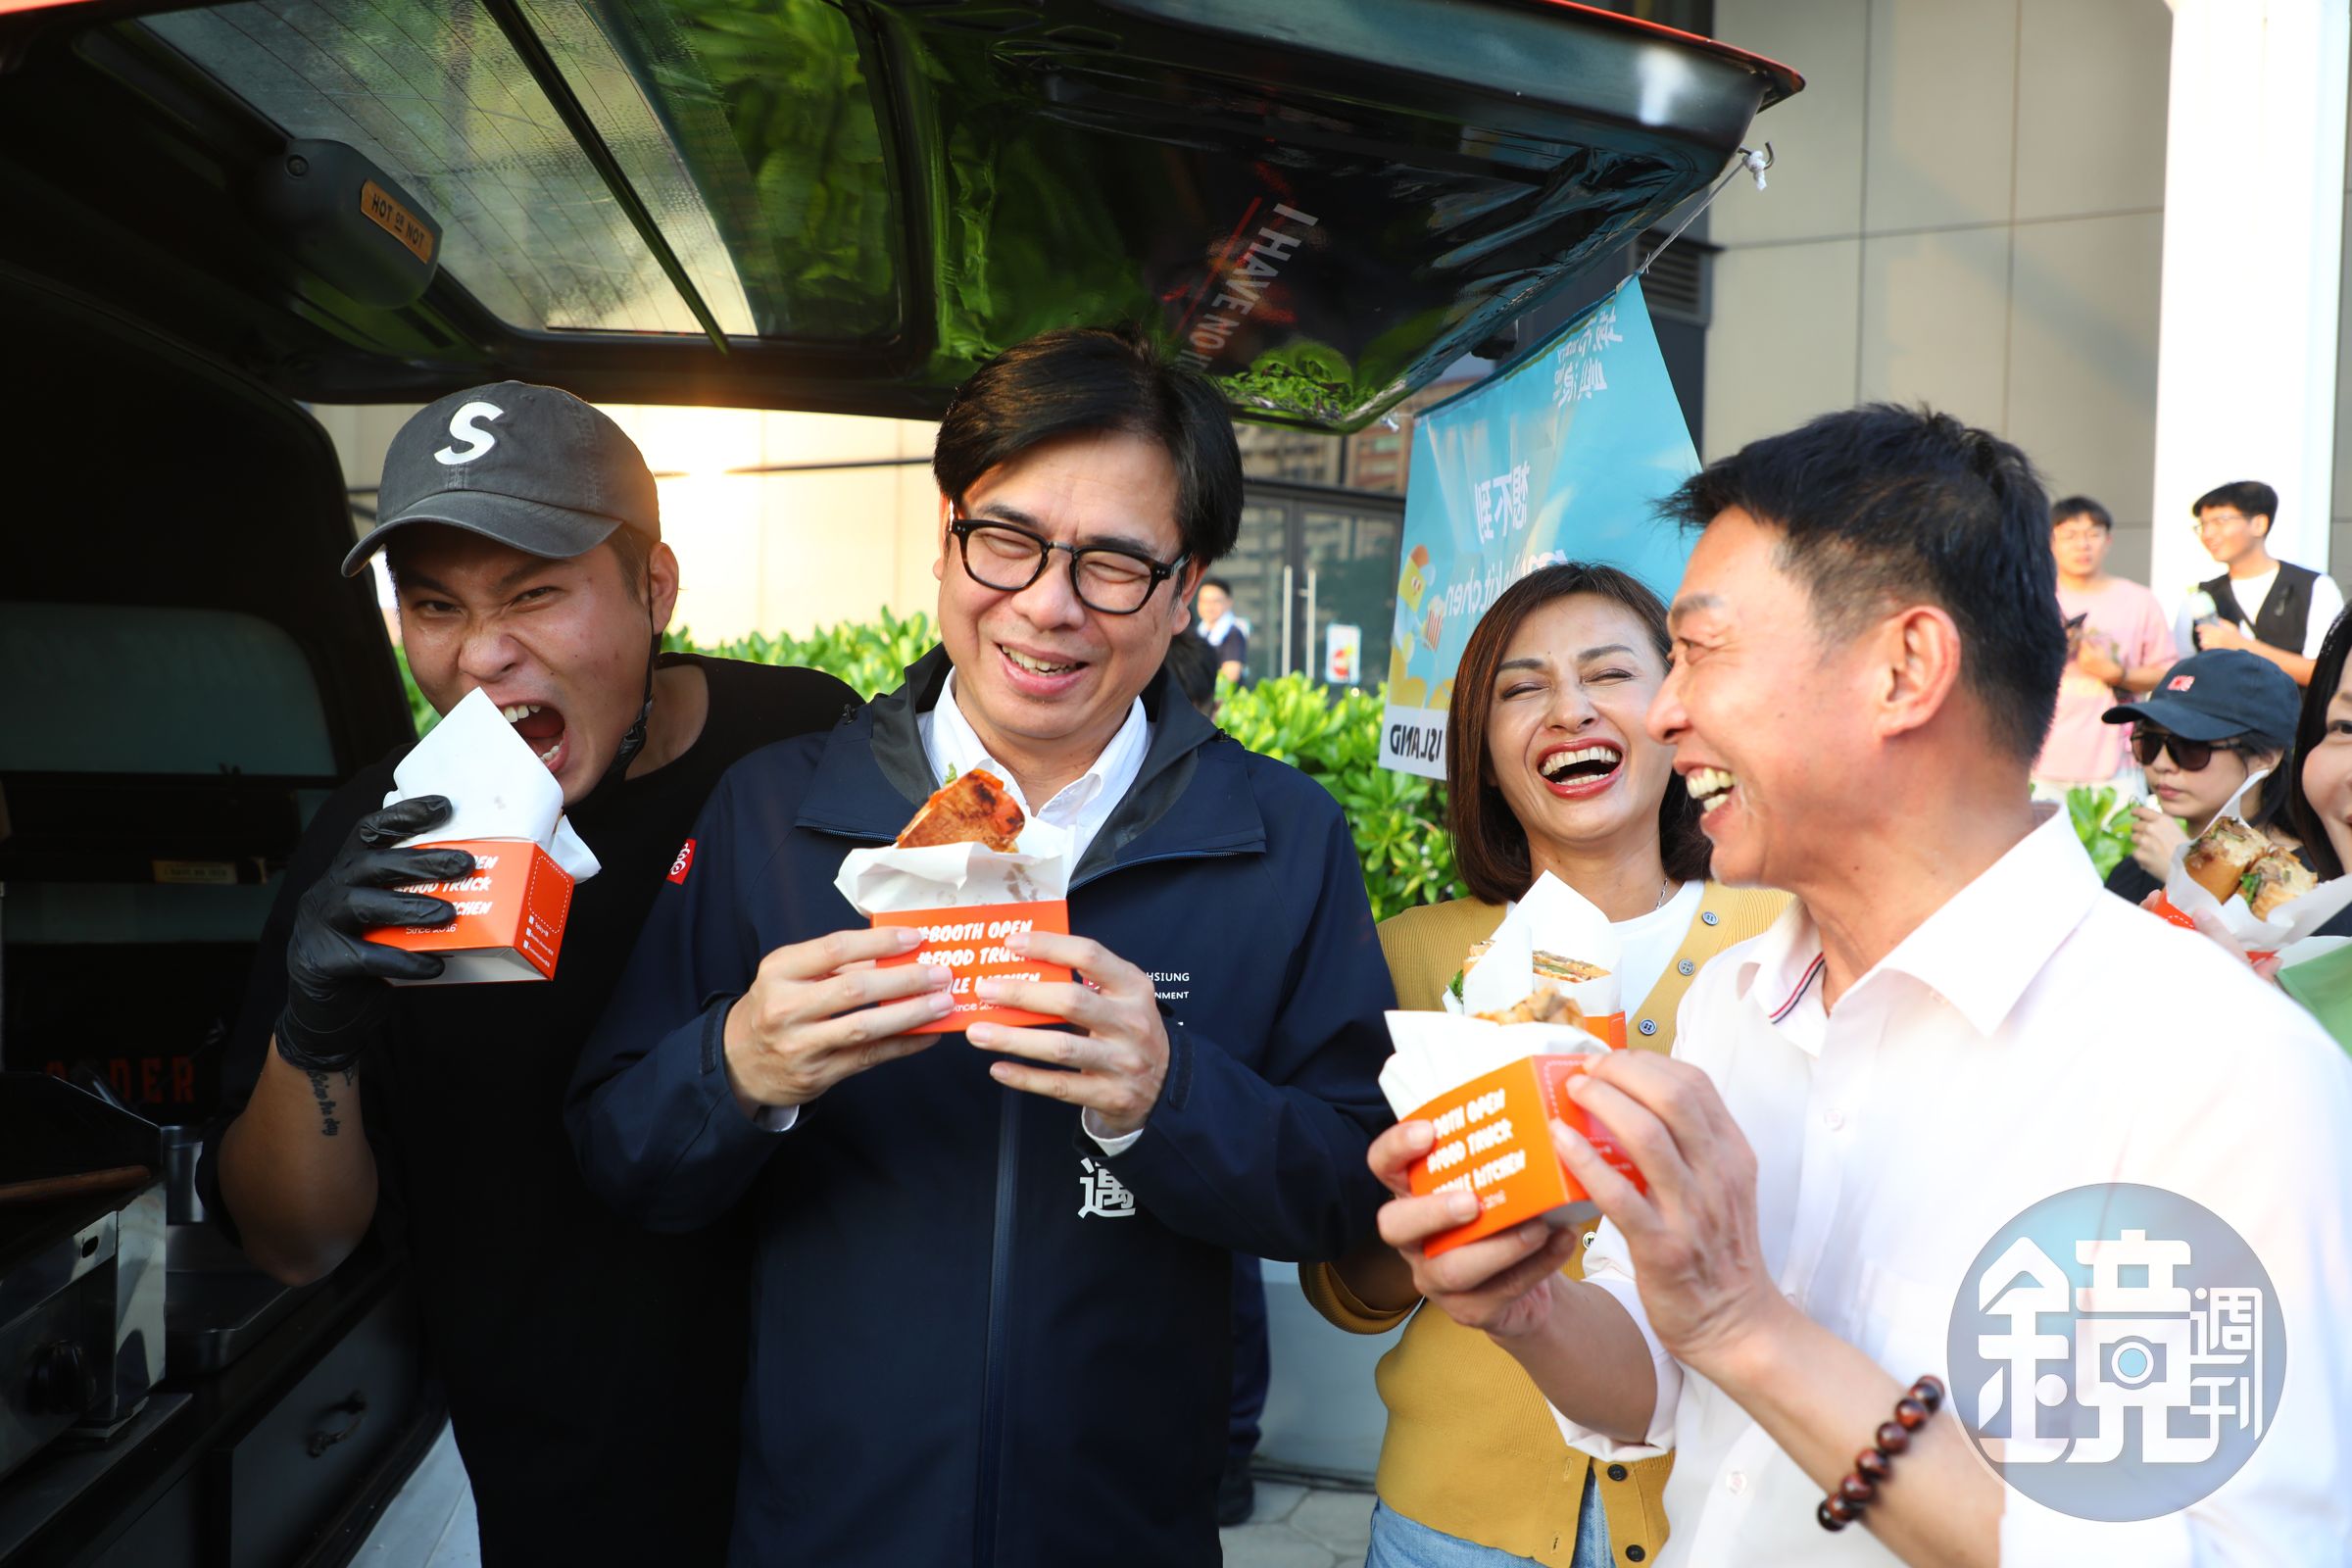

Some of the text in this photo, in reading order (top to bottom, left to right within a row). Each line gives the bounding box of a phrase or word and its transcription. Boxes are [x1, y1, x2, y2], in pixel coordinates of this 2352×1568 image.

[371, 194, 393, 222] HOT
[407, 222, 425, 249] NOT
[1273, 203, 1319, 226] I
[1211, 226, 1301, 316] HAVE
[1189, 313, 1240, 349] NO
[434, 401, 505, 466] S
[453, 902, 493, 915] CHEN
[988, 919, 1034, 941] OPEN
[916, 950, 976, 967] #FOOD
[1466, 1088, 1505, 1123] OPEN
[1466, 1117, 1514, 1155] TRUCK
[1078, 1157, 1136, 1218] 遇
